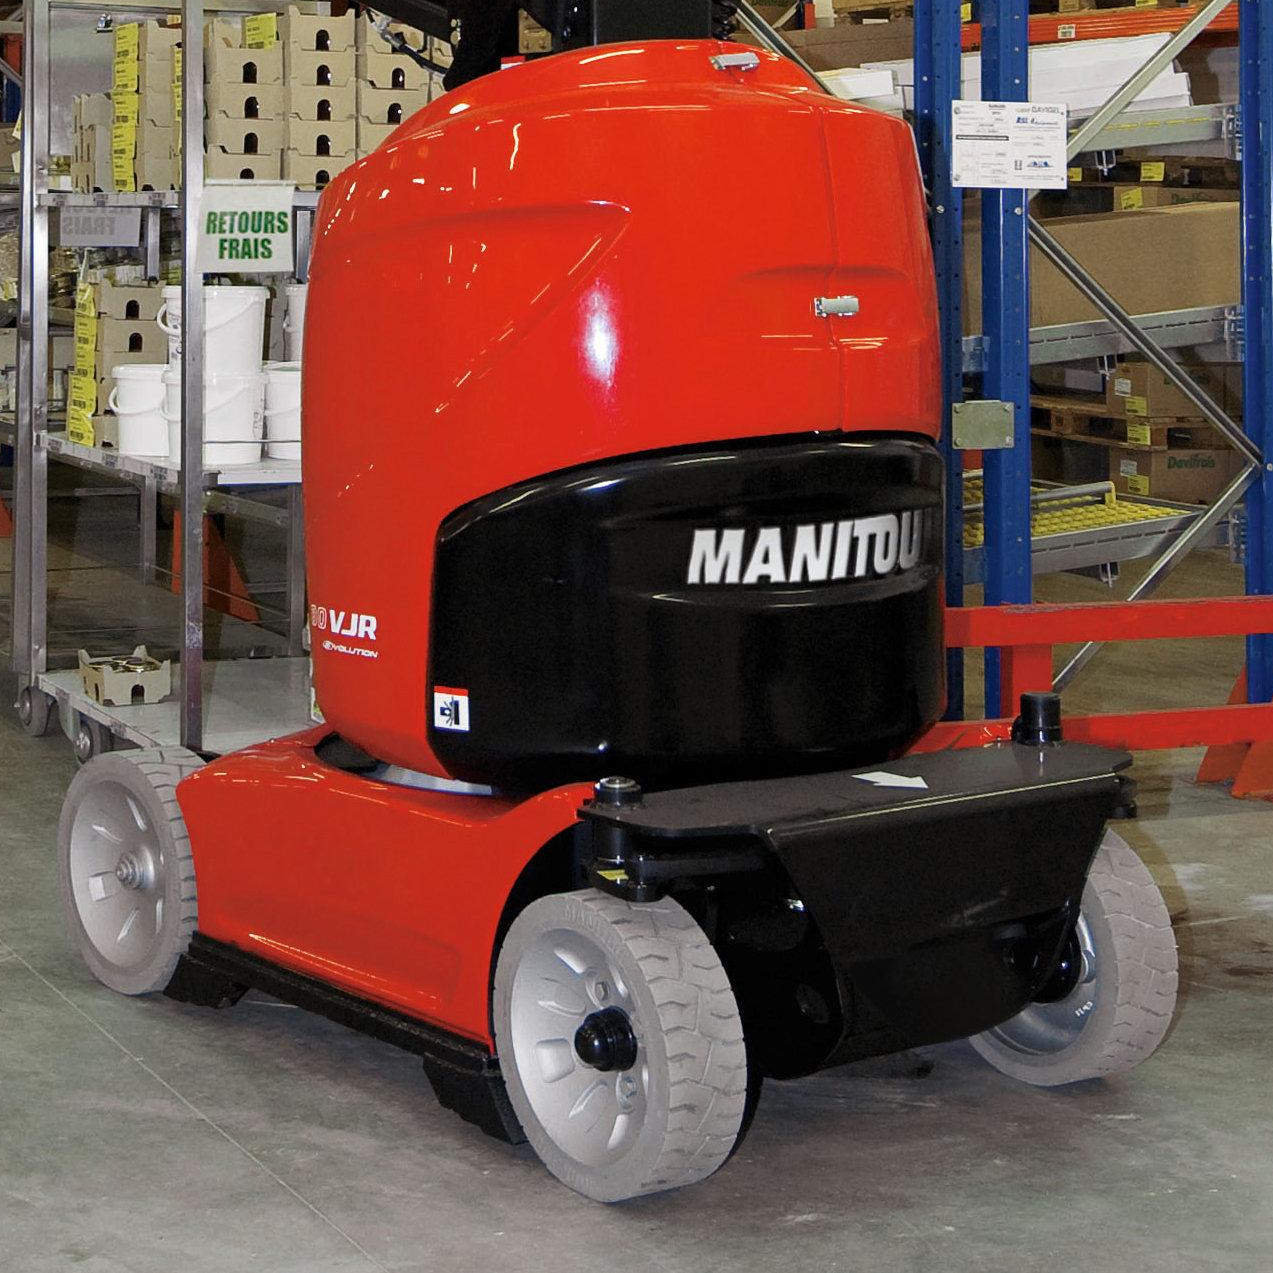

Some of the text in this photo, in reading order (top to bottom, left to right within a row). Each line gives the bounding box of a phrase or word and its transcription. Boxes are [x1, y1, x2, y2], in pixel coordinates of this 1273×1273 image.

[205, 211, 289, 234] RETOURS
[218, 238, 273, 260] FRAIS
[1168, 454, 1215, 468] Davifrais
[687, 510, 922, 584] MANITOU
[329, 609, 377, 641] VJR
